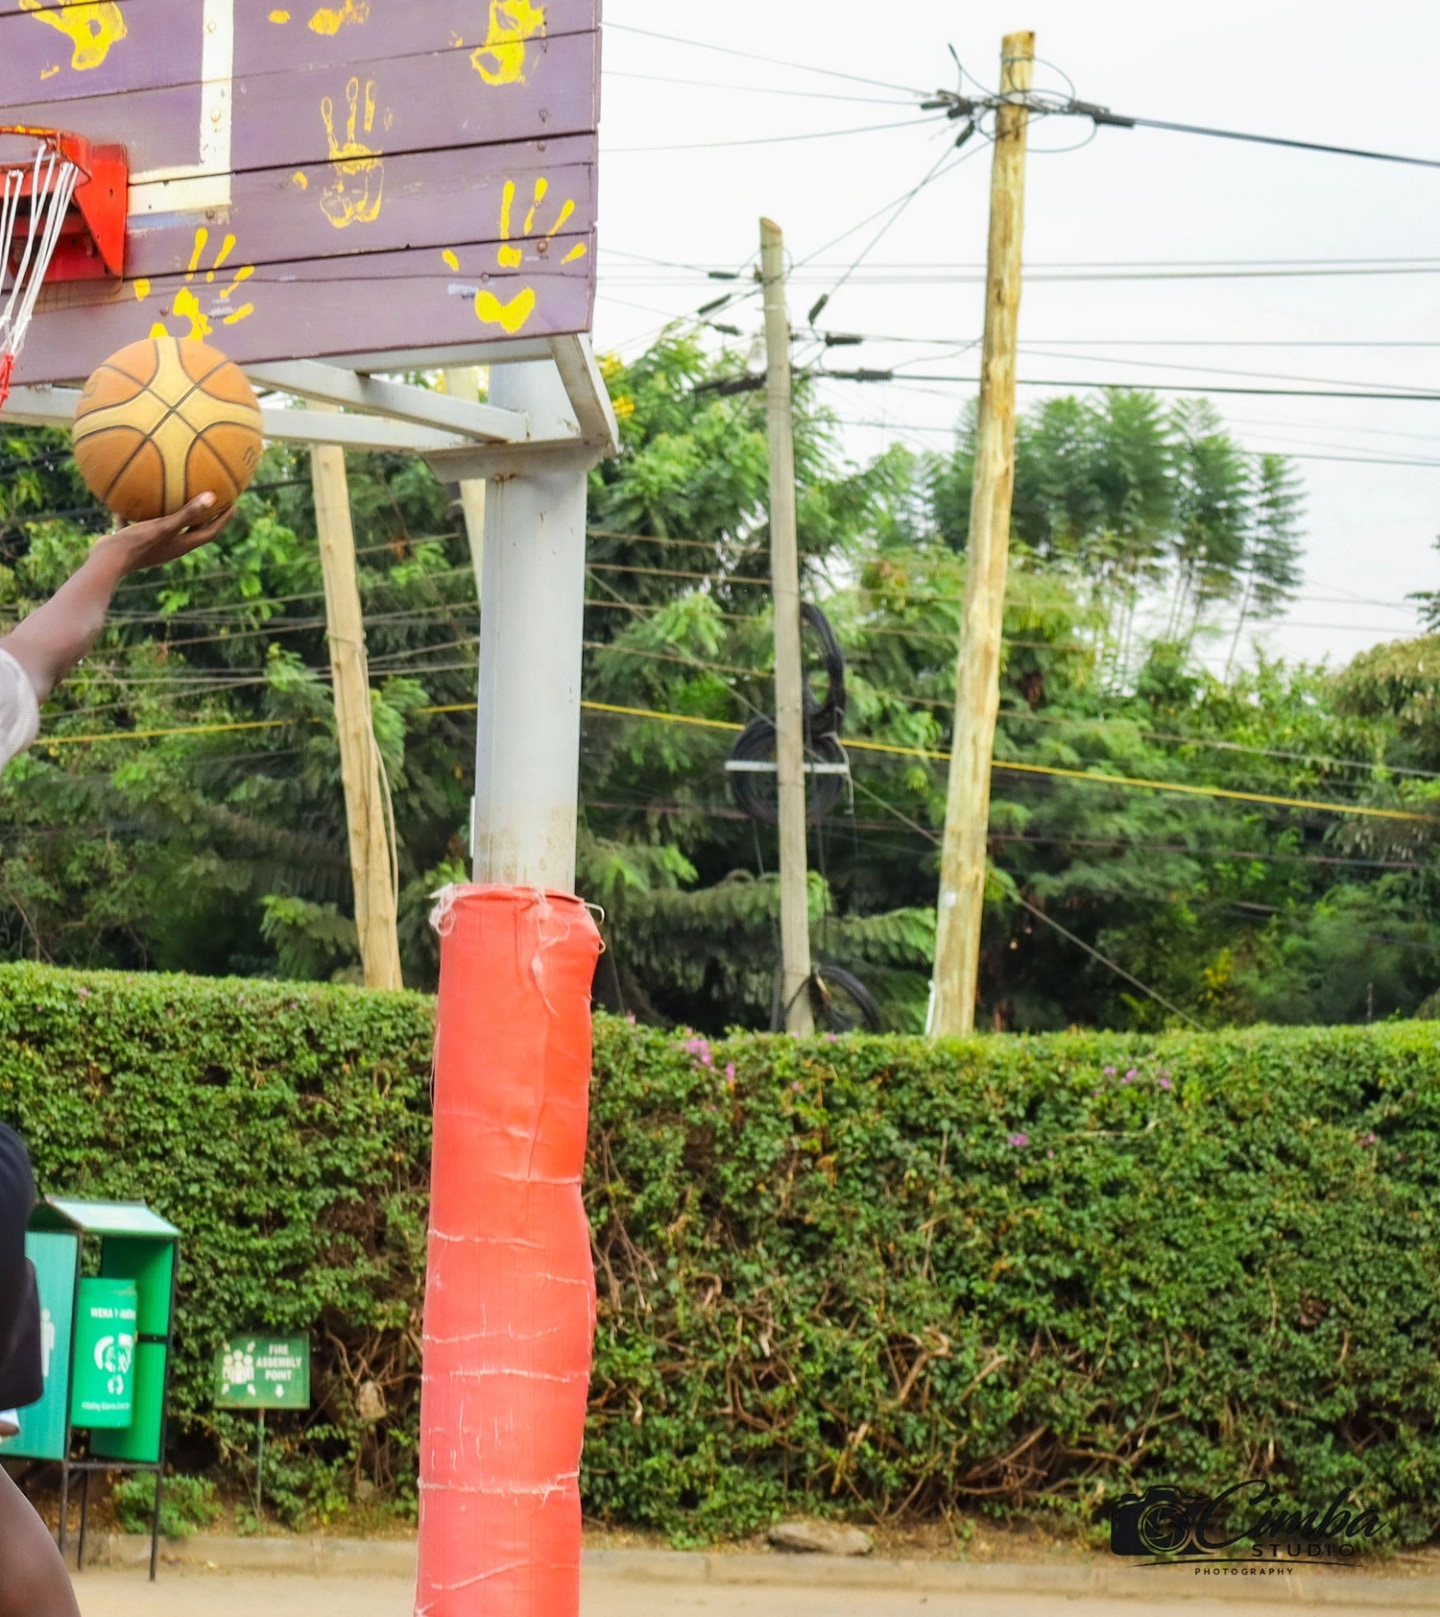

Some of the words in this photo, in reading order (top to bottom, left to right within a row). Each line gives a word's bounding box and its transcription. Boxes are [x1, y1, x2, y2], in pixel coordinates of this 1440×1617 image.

[269, 1344, 289, 1355] FIRE
[256, 1356, 302, 1368] ASSEMBLY
[265, 1369, 292, 1381] POINT
